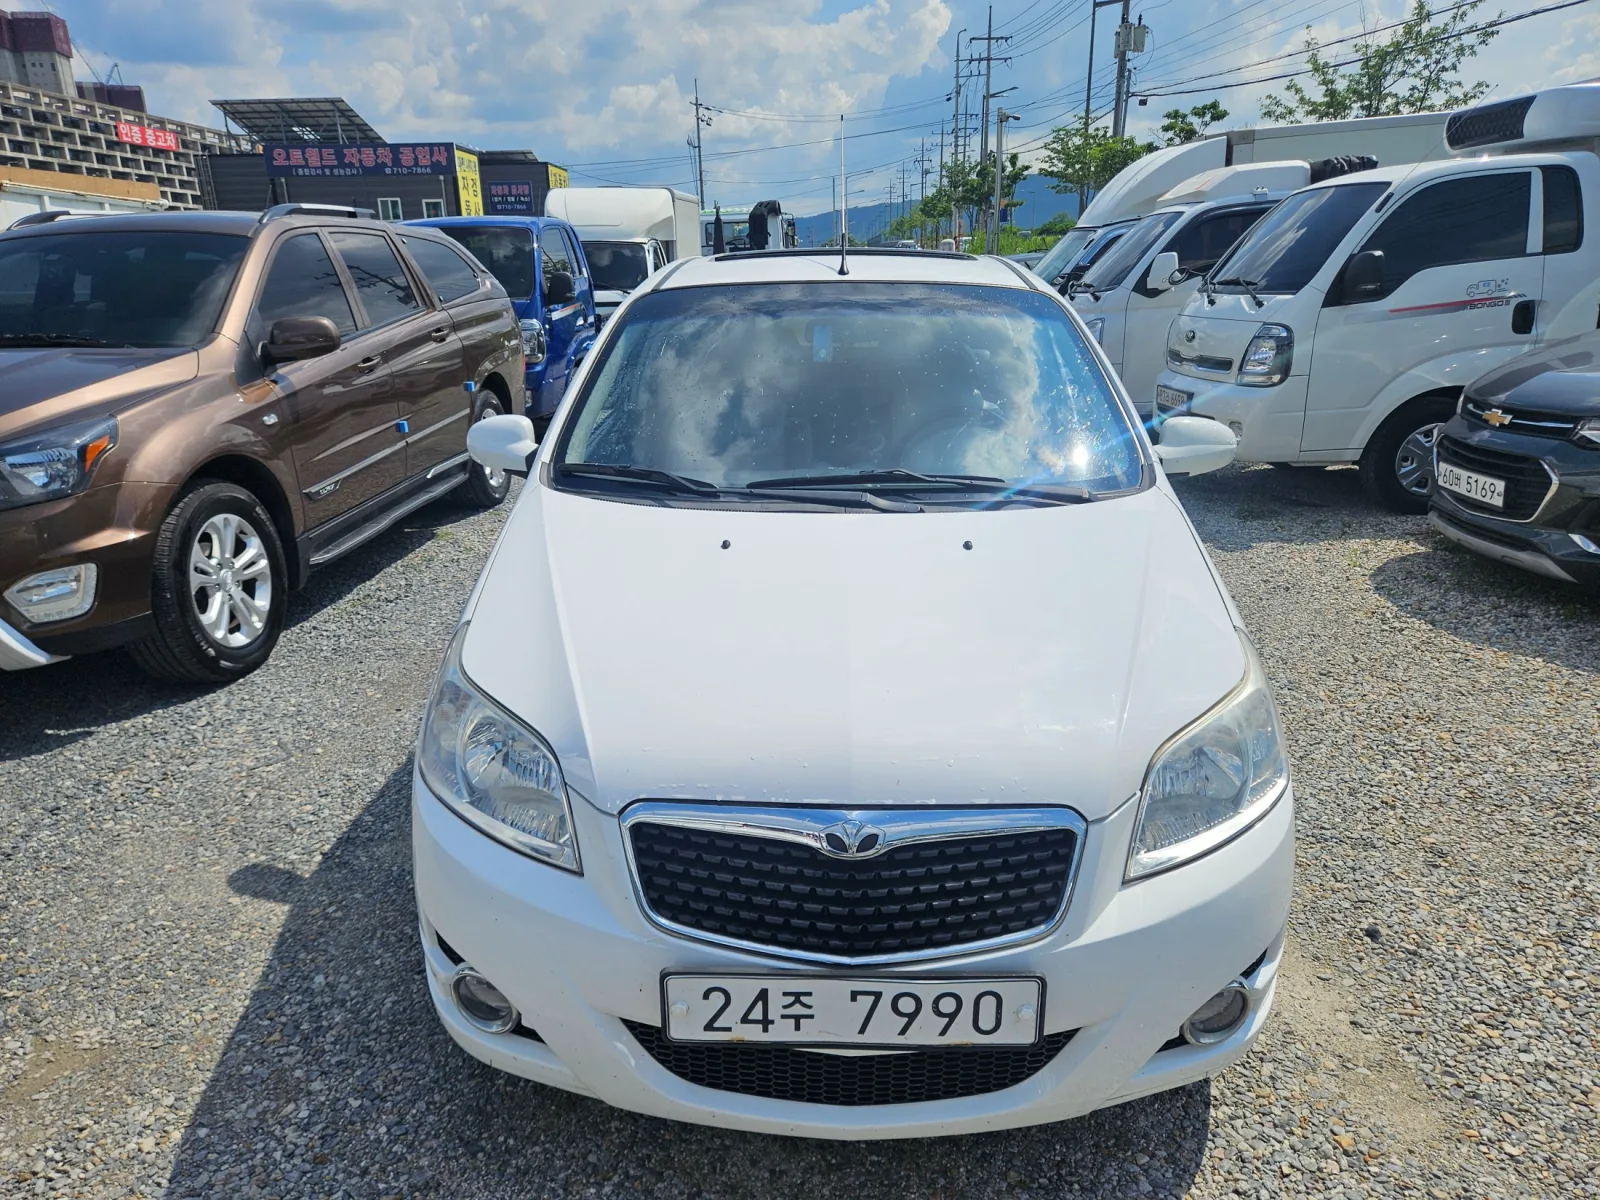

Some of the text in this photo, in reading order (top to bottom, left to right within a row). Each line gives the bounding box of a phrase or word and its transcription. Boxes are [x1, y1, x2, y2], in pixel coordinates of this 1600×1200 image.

[120, 124, 176, 150] 인증 중고차
[273, 146, 447, 167] 오토월드 자동차 공업사
[1469, 300, 1504, 310] BONGO
[1442, 467, 1497, 501] 60버 5169
[701, 986, 1004, 1037] 24주 7990
